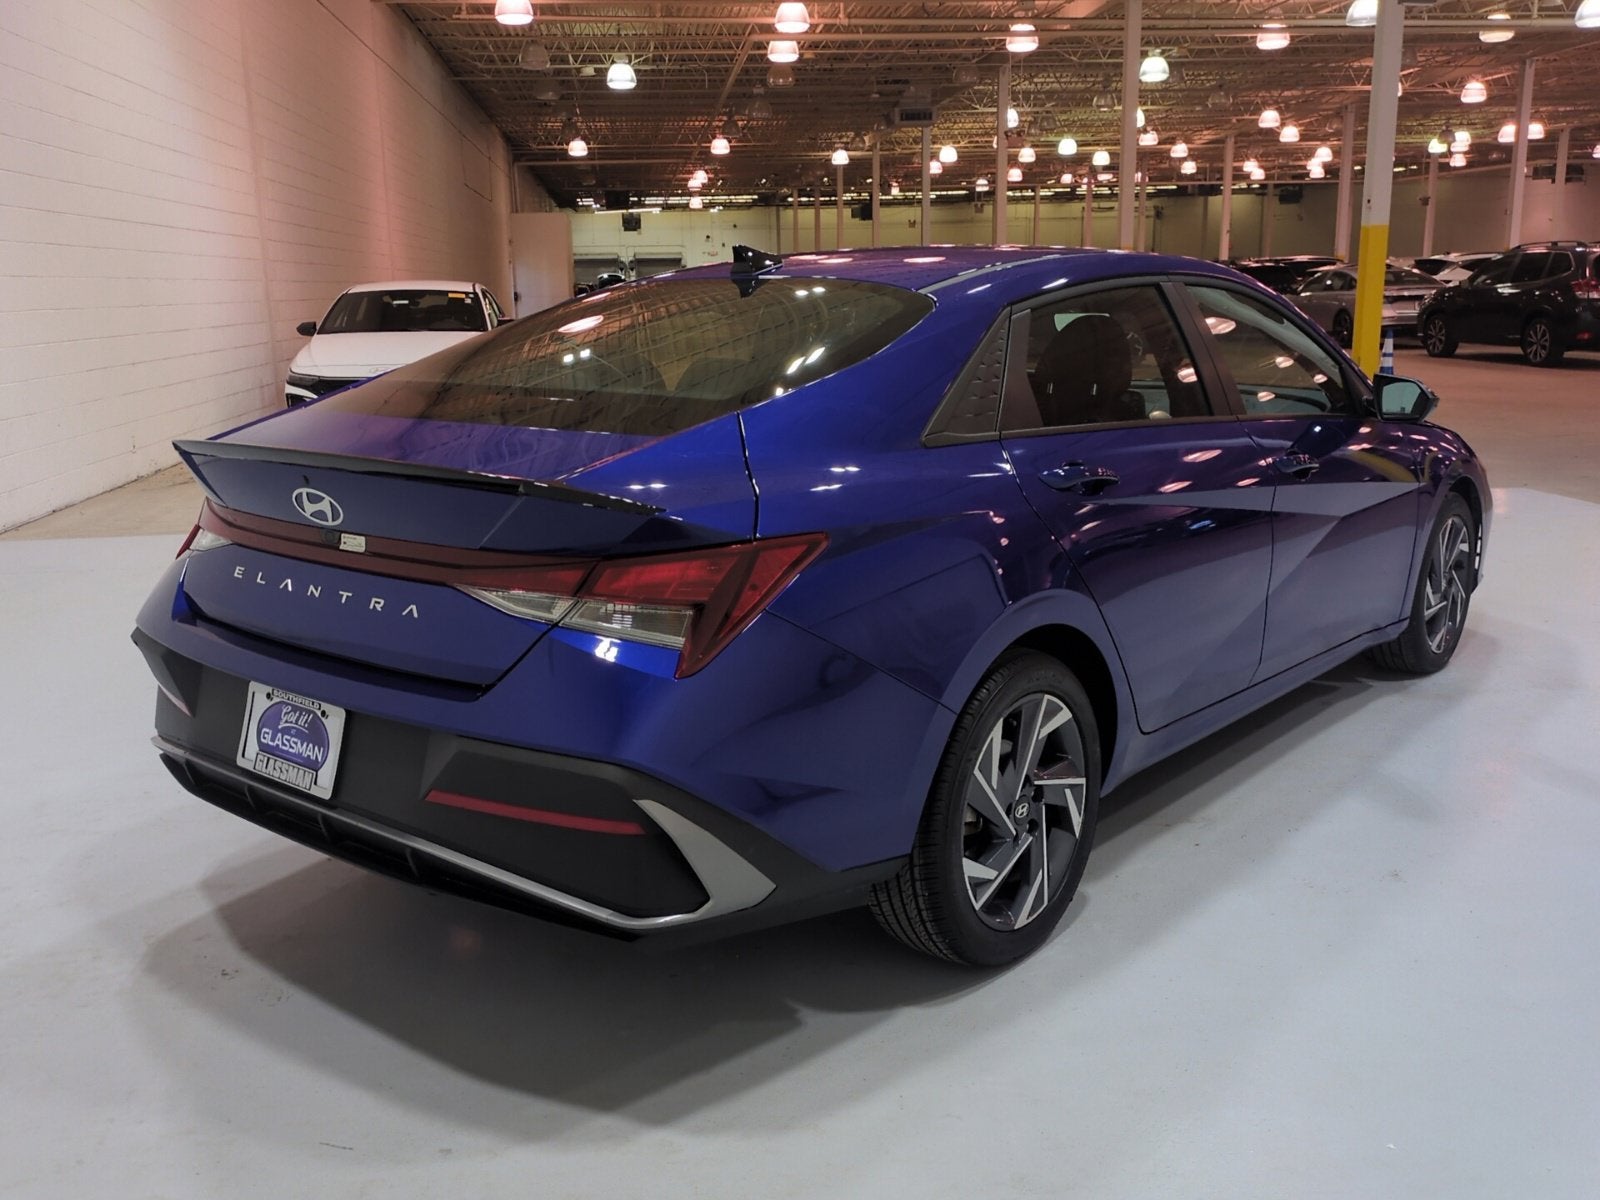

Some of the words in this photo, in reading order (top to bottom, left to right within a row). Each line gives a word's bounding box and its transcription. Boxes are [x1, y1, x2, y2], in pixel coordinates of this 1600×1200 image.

[233, 566, 418, 618] ELANTRA
[273, 689, 321, 710] SOUTHFIELD
[281, 704, 300, 726] Got
[299, 712, 313, 728] it!
[260, 728, 323, 761] GLASSMAN
[255, 755, 313, 790] GLASSMAN
